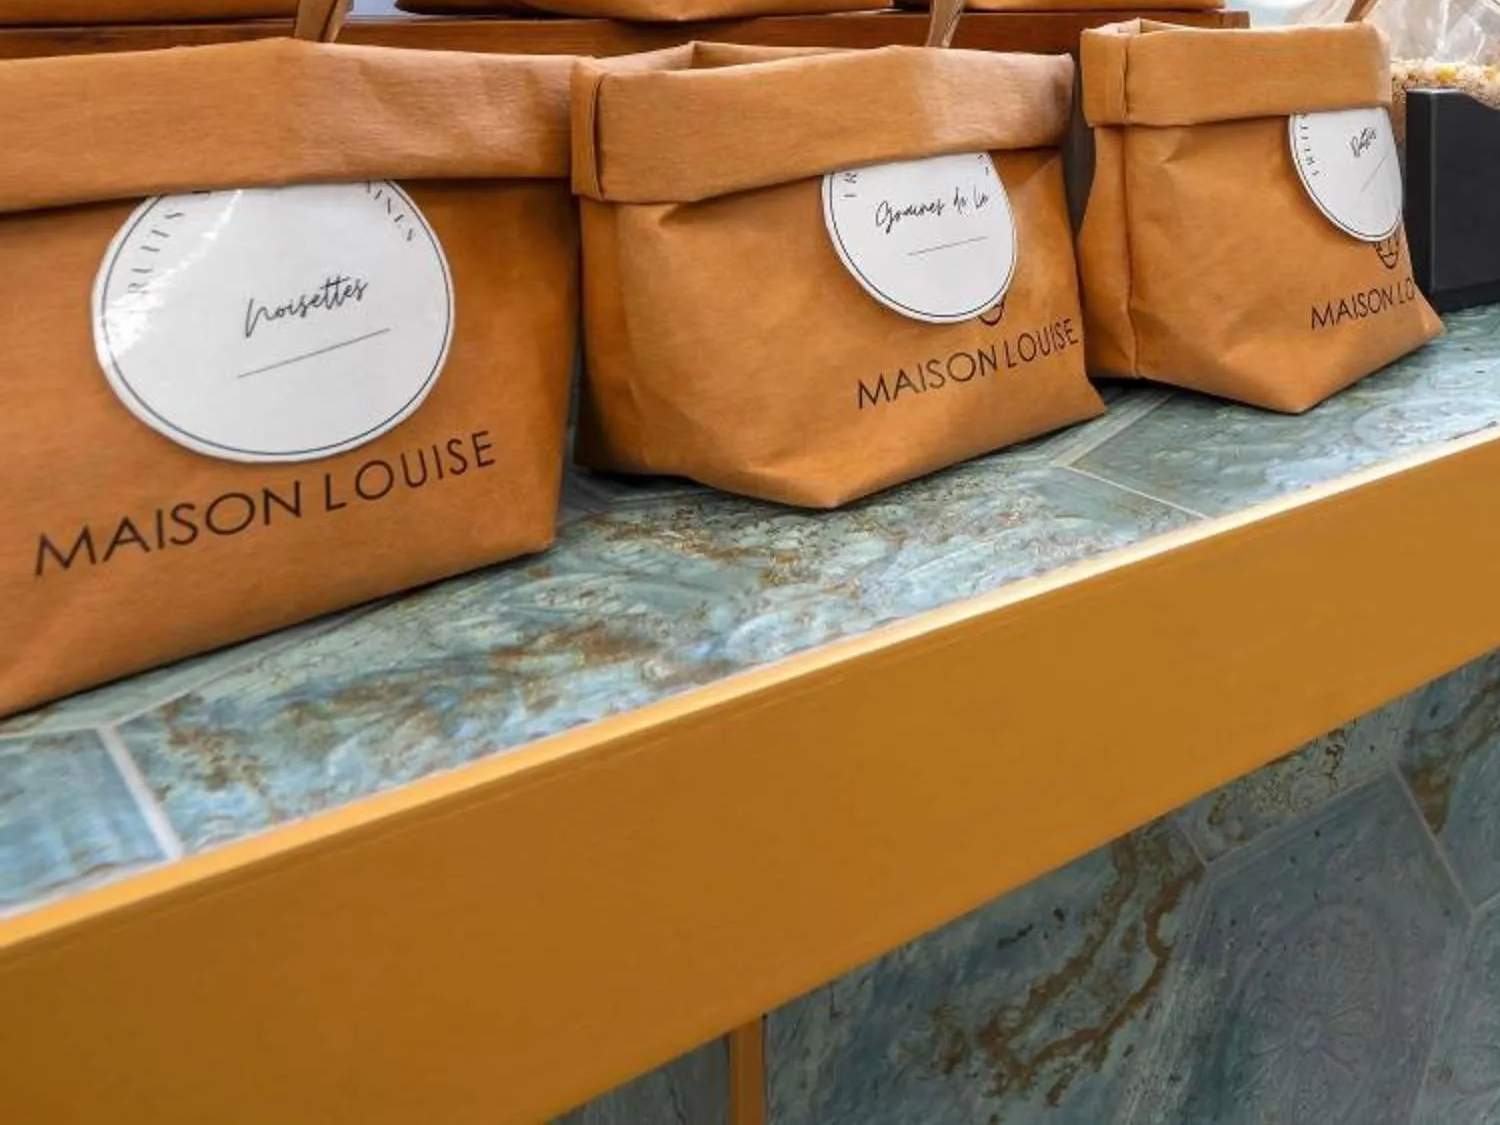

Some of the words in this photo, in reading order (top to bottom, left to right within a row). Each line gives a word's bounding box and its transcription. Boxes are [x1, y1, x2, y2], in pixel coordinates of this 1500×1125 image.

[1311, 284, 1393, 330] MAISON
[858, 345, 998, 410] MAISON
[1003, 318, 1080, 369] LOUISE
[36, 480, 301, 577] MAISON
[324, 431, 496, 511] LOUISE
